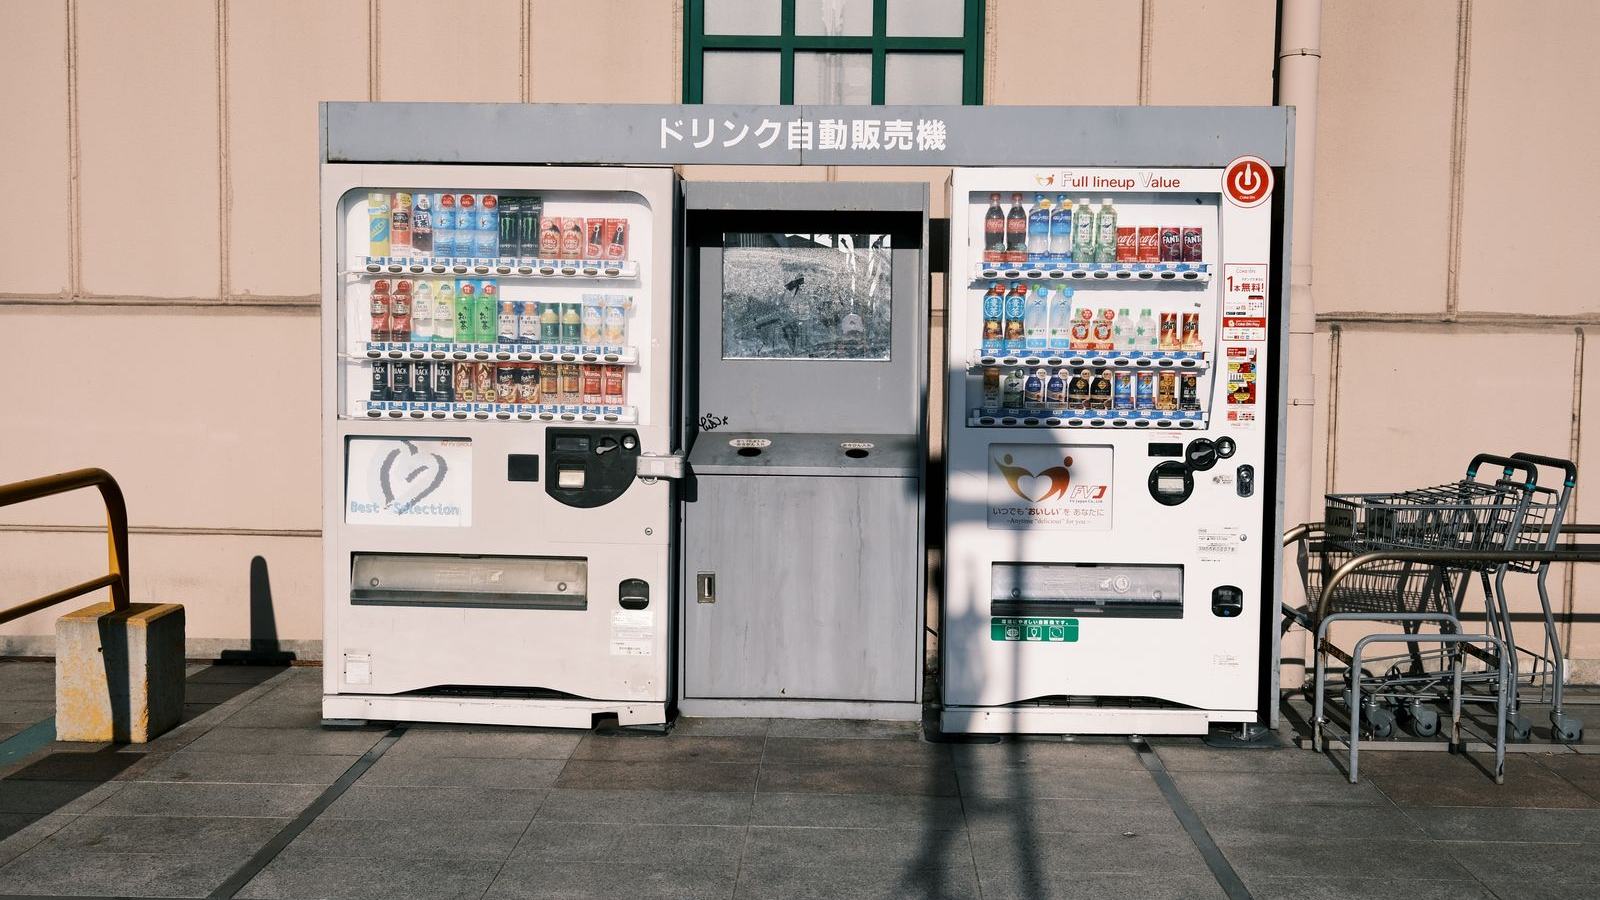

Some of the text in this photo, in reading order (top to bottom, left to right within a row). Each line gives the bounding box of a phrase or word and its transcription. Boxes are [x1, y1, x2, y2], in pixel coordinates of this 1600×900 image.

[660, 118, 947, 151] ドリンク自動販売機
[1061, 172, 1180, 191] Full lineup Value
[350, 501, 460, 516] Best Selection
